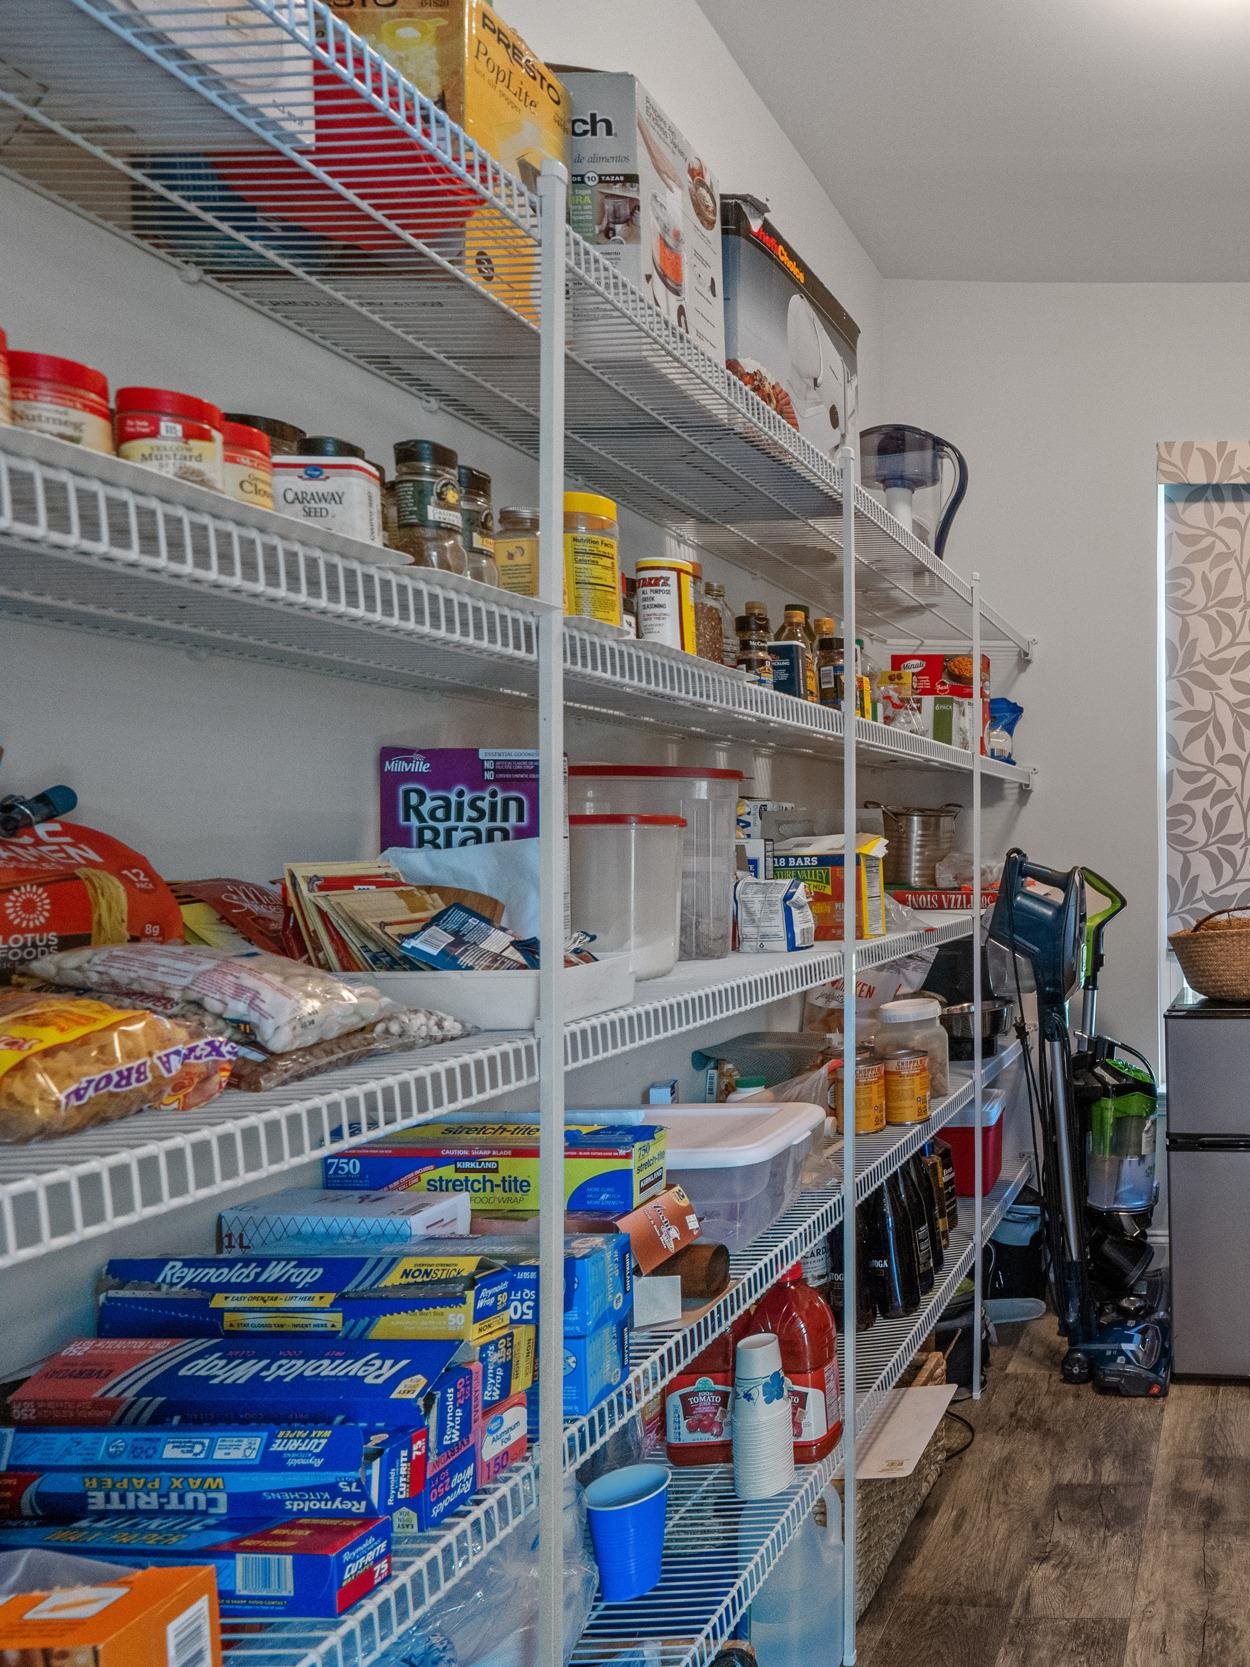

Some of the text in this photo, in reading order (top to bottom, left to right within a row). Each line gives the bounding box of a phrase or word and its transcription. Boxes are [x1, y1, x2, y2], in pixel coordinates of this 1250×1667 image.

[482, 11, 561, 106] PRESTO
[475, 38, 537, 109] PopLite
[587, 174, 597, 183] 10
[140, 451, 204, 463] Mustard
[283, 488, 345, 505] CARAWAY
[302, 506, 329, 518] SEED
[384, 760, 432, 773] Millville
[484, 761, 494, 769] NO
[484, 771, 494, 780] NO
[401, 787, 526, 824] Raisin
[416, 825, 510, 850] Bran
[774, 857, 818, 867] 18 BARS
[121, 869, 149, 882] 12
[797, 869, 828, 884] VALLEY
[904, 894, 976, 909] PIZZA STONE
[144, 923, 160, 936] 8g
[0, 932, 59, 948] LOTUS
[441, 1125, 540, 1137] stretch-tite
[327, 1158, 361, 1175] 750
[456, 1161, 498, 1169] KIRKLAND
[426, 1174, 532, 1194] stretch-tite
[155, 1260, 324, 1290] Reynolds Wrap
[400, 1267, 464, 1280] NONSTICK
[479, 1281, 510, 1299] Reynolds
[509, 1290, 536, 1300] SQ FT
[476, 1293, 508, 1310] Wrap 50
[509, 1301, 534, 1320] 50
[448, 1313, 465, 1326] 50
[178, 1352, 411, 1384] Reynolds Wrap
[484, 1344, 495, 1401] Reynolds
[456, 1377, 465, 1406] 250
[491, 1366, 504, 1401] Wrap
[688, 1396, 722, 1405] TOMATO
[444, 1387, 454, 1446] Reynolds
[276, 1430, 333, 1438] WAX PAPER
[451, 1409, 463, 1443] Wrap
[491, 1421, 521, 1447] Aluminum
[269, 1438, 329, 1453] CUT-RITE
[500, 1434, 512, 1446] Foil
[412, 1442, 424, 1460] 75
[286, 1457, 324, 1467] Reynolds
[485, 1450, 509, 1481] 150
[397, 1449, 409, 1499] CUT-RITE
[451, 1463, 475, 1488] Wrap
[84, 1477, 224, 1489] WAX PAPER
[338, 1481, 361, 1493] 75
[388, 1467, 396, 1506] Reynolds
[430, 1477, 451, 1502] 250
[87, 1491, 228, 1514] CUT-RITE
[262, 1491, 330, 1500] KITCHENS
[431, 1477, 473, 1518] Reynolds
[285, 1500, 366, 1513] Reynolds
[342, 1535, 376, 1563] Reynolds
[344, 1541, 388, 1580] CUT-RITE
[373, 1558, 389, 1579] 75
